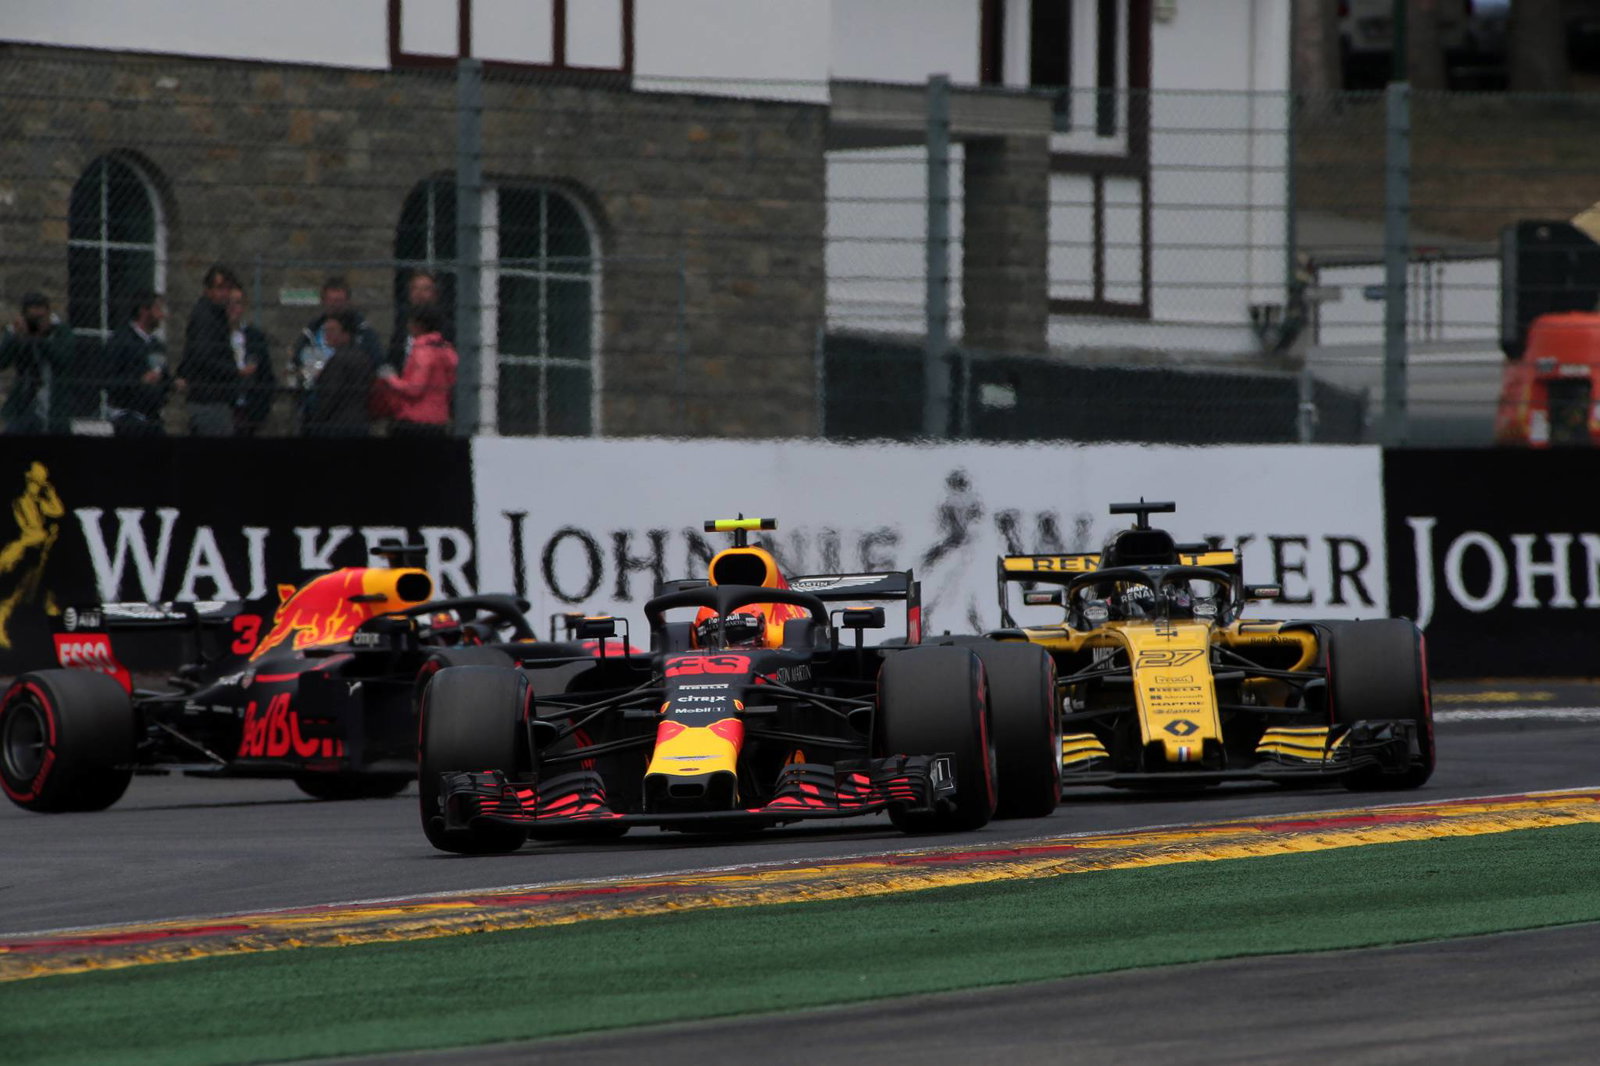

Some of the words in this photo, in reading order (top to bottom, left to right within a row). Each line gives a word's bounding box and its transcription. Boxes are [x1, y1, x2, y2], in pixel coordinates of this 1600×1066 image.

[1032, 553, 1206, 571] RENT
[232, 614, 262, 655] 3
[665, 655, 750, 677] 33
[1136, 649, 1205, 669] 27
